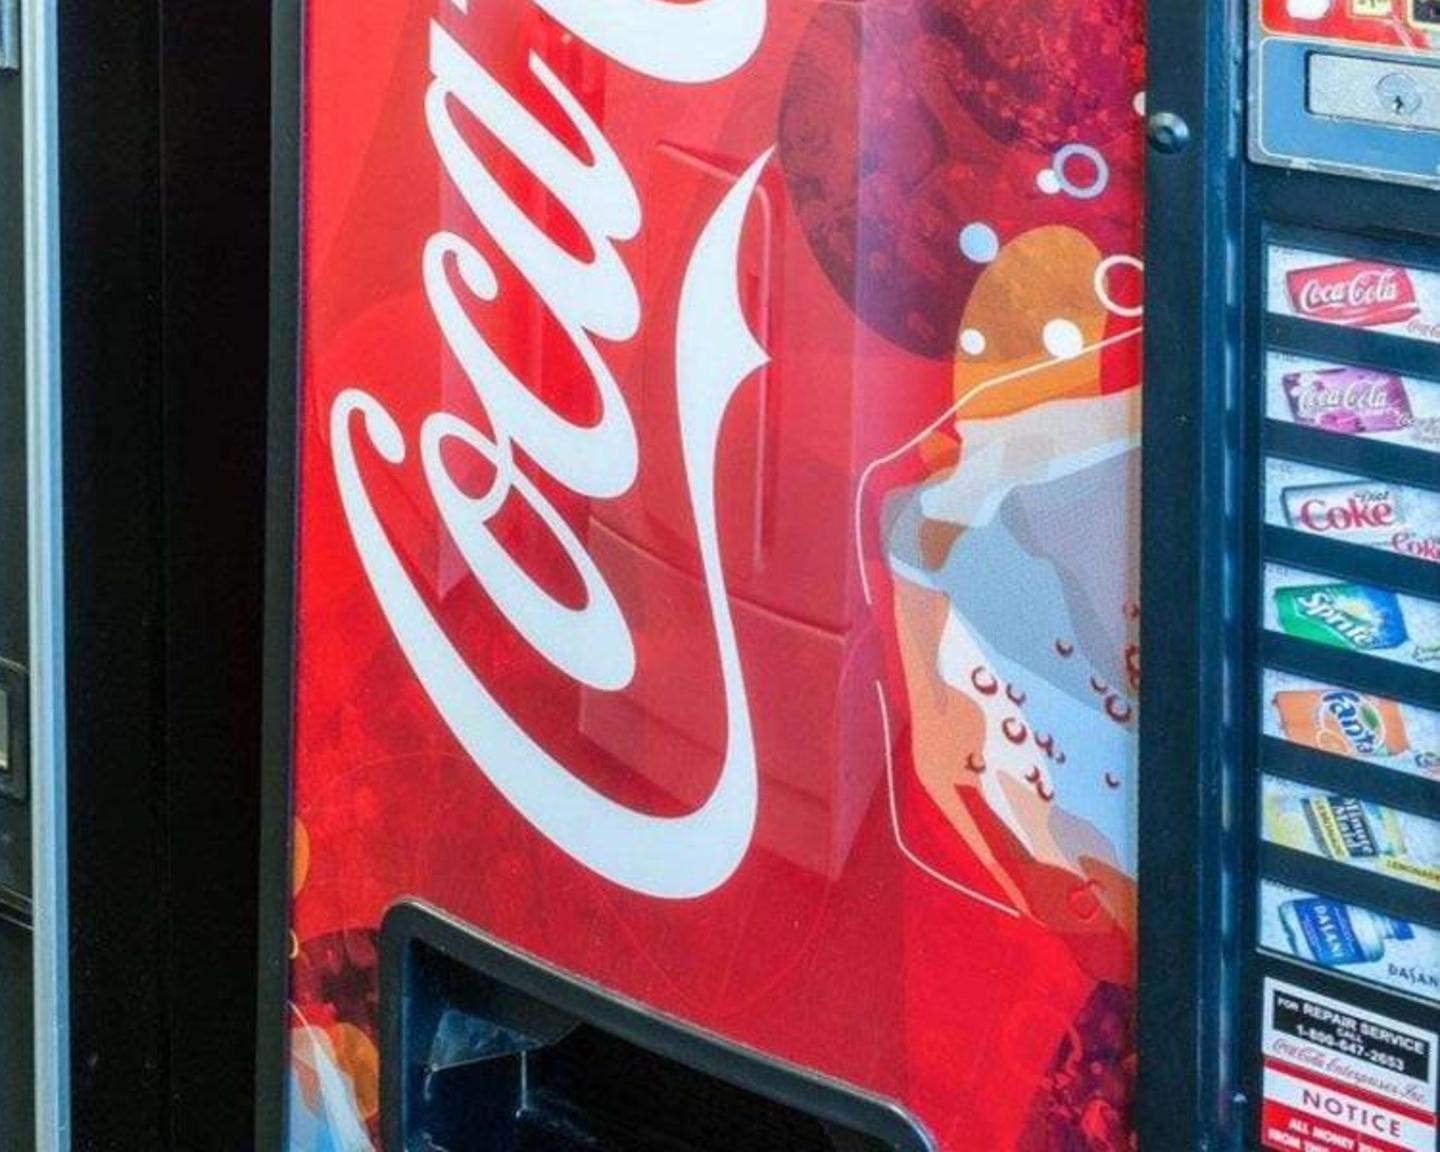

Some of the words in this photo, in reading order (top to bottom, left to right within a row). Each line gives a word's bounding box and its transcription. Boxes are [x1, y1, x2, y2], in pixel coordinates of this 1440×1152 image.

[1300, 498, 1393, 532] Coke
[1298, 590, 1374, 648] Sprite
[1323, 690, 1375, 754] Fanta
[1302, 999, 1359, 1032] REPAIR
[1359, 1016, 1425, 1055] SERVICE
[1302, 1089, 1402, 1138] NOTICE
